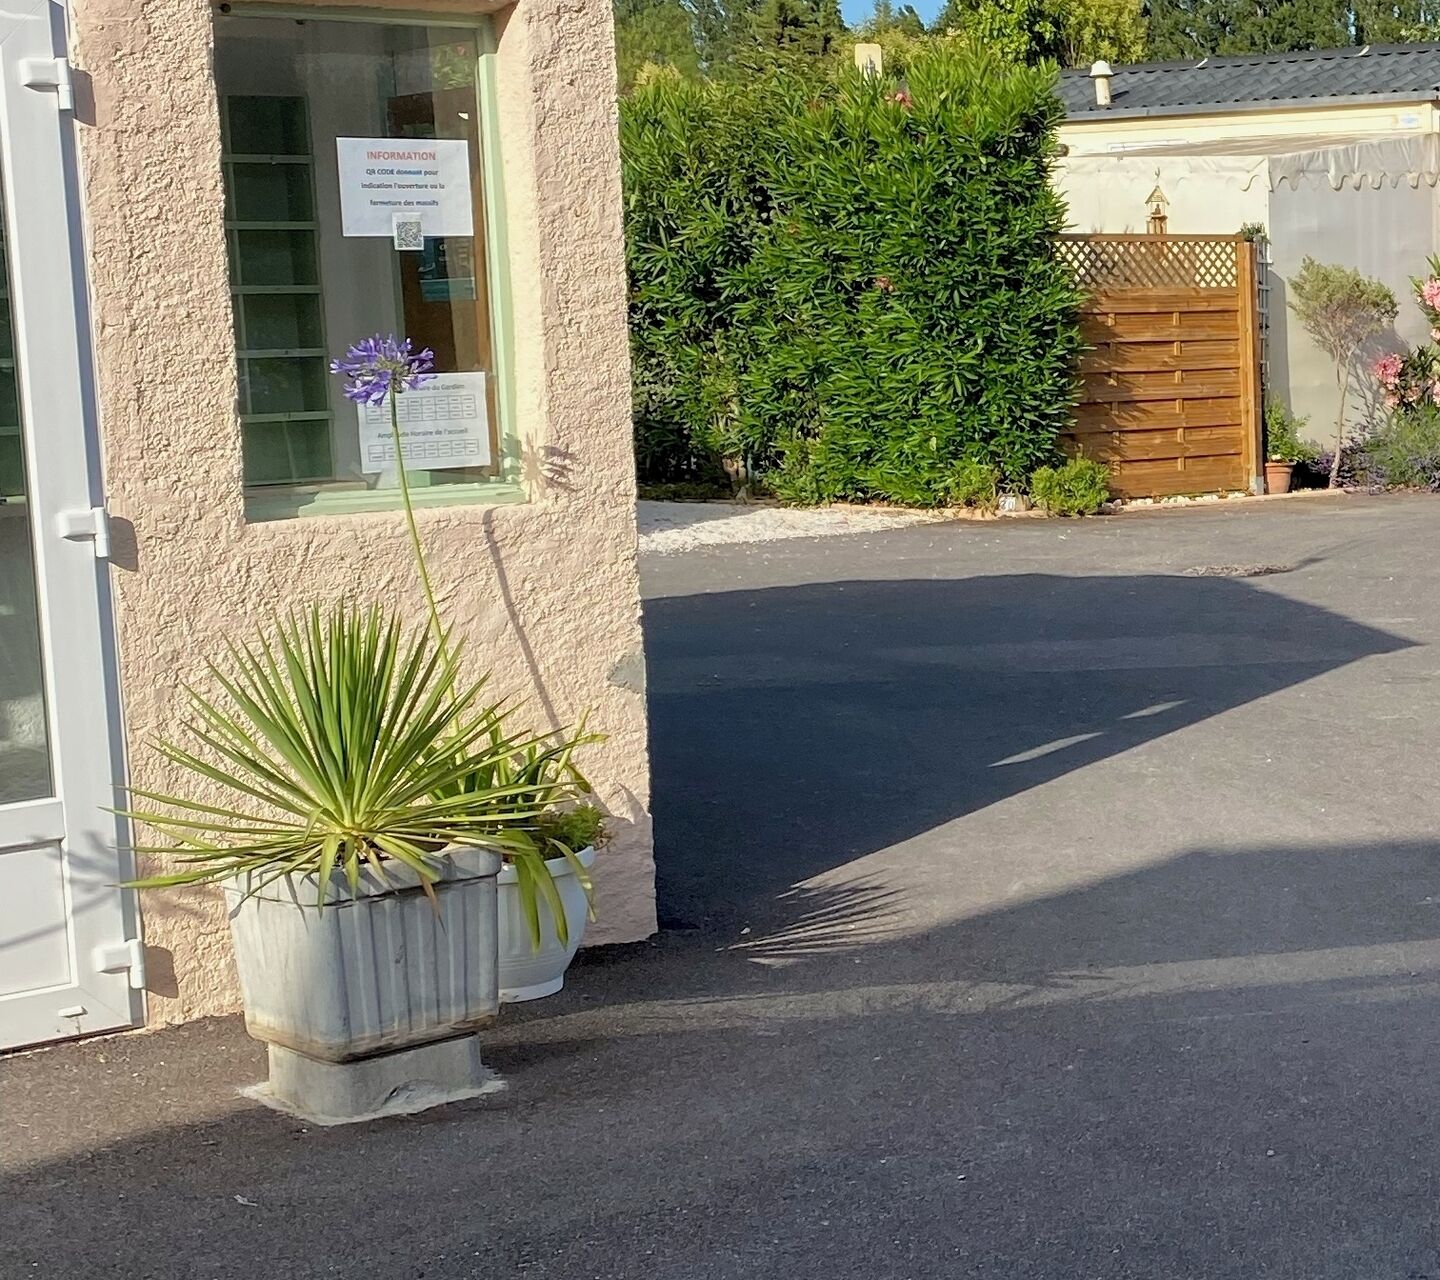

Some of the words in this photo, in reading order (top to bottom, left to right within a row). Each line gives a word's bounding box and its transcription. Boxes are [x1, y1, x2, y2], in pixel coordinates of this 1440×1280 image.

[366, 150, 436, 161] INFORMATION
[365, 168, 376, 176] QR
[376, 168, 395, 176] CODE
[423, 169, 439, 177] pour
[403, 199, 415, 207] des
